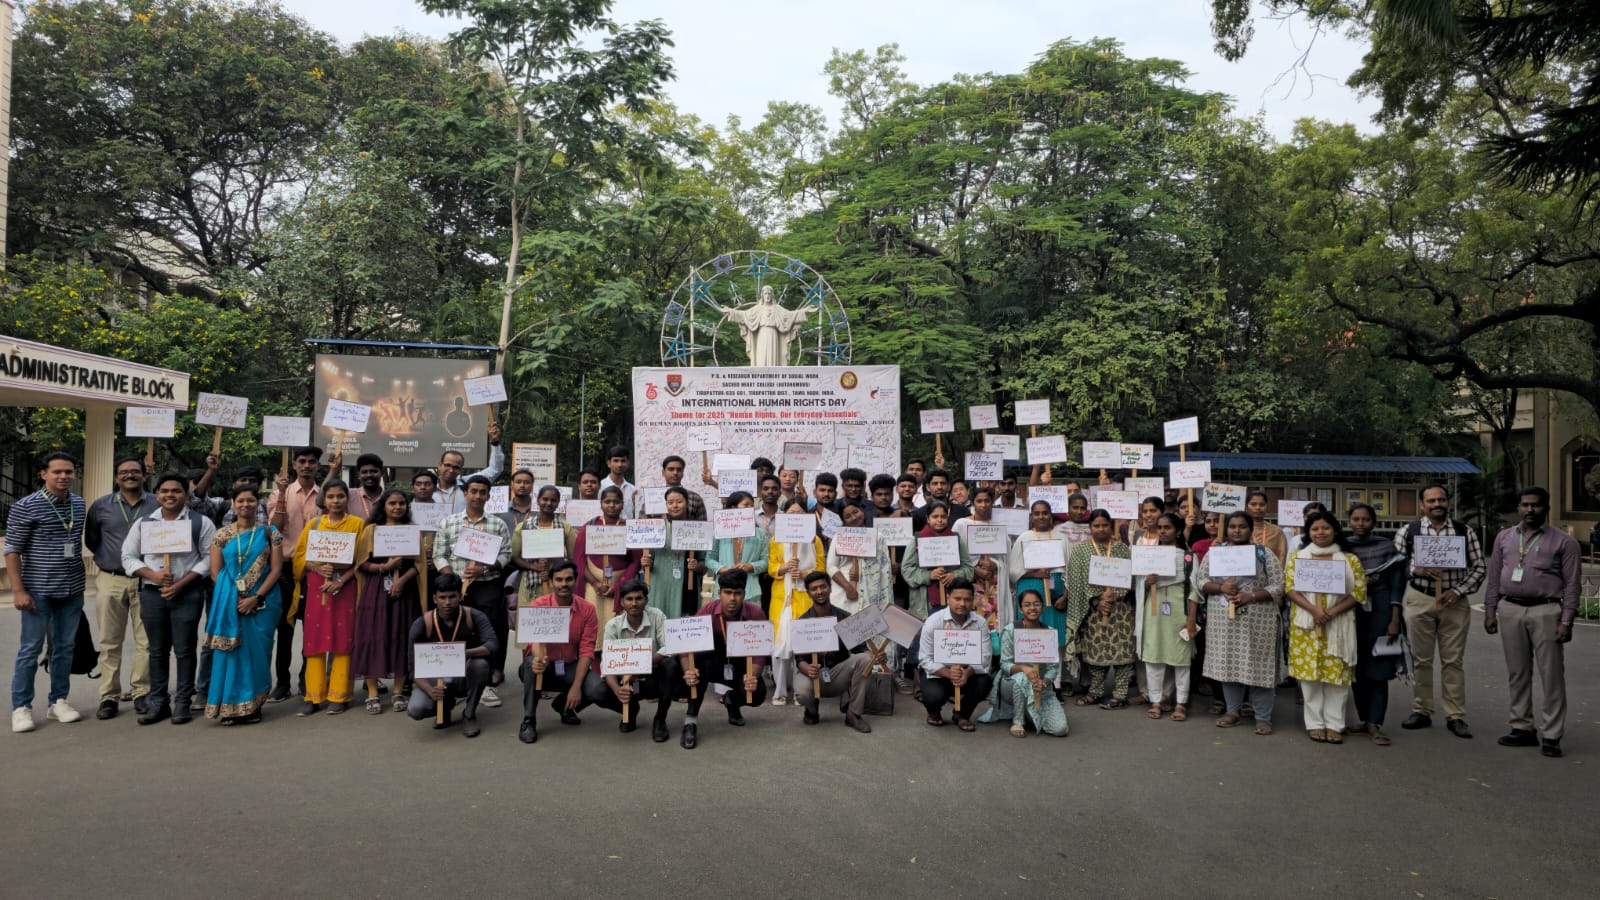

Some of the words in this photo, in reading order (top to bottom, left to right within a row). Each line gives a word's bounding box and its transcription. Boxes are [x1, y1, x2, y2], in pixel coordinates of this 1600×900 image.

[0, 353, 129, 393] ADMINISTRATIVE
[132, 376, 175, 400] BLOCK
[681, 398, 756, 407] INTERNATIONAL
[758, 398, 791, 407] HUMAN
[793, 398, 826, 407] RIGHTS
[828, 398, 847, 407] DAY
[793, 411, 822, 420] Everyday
[317, 537, 349, 549] Liberty
